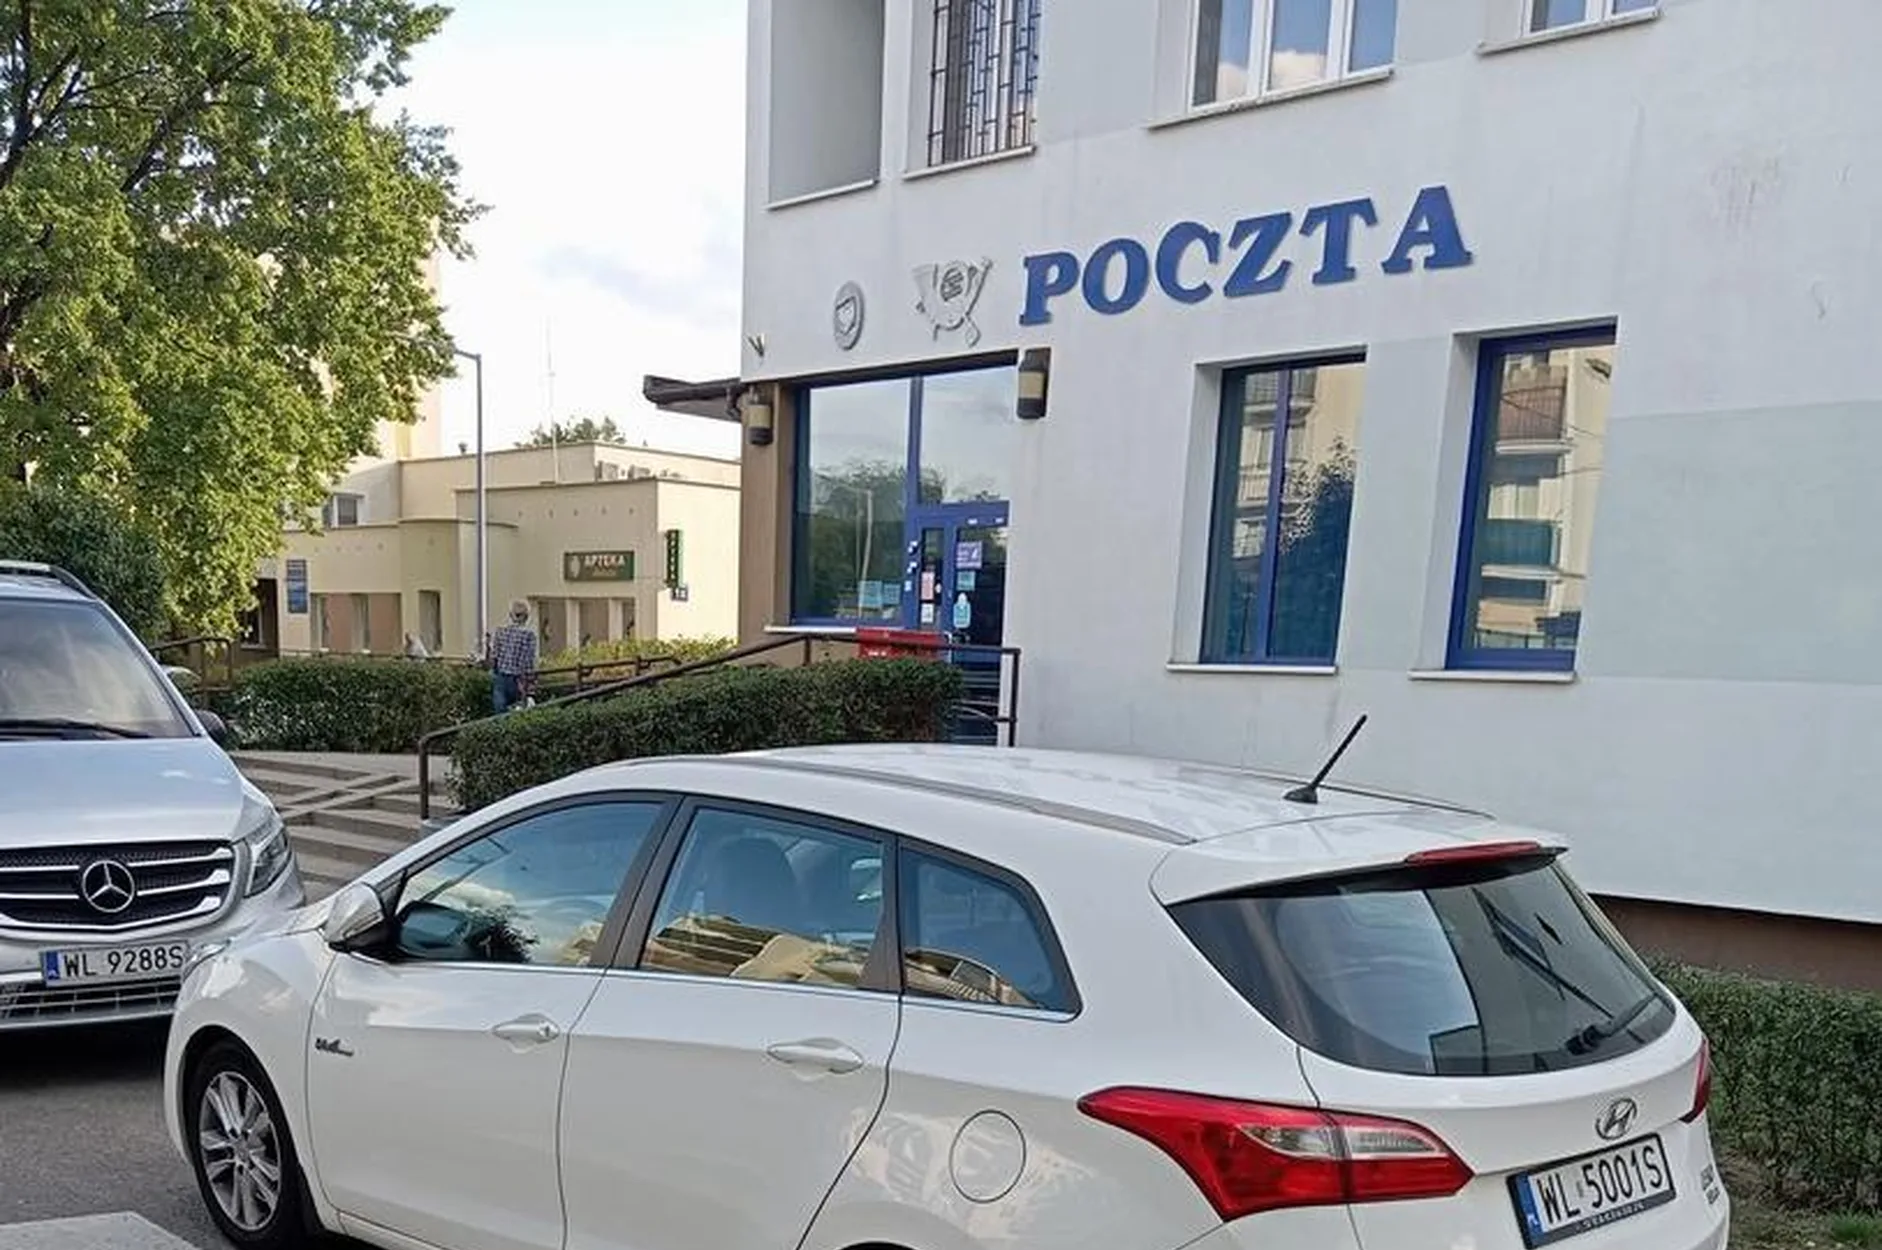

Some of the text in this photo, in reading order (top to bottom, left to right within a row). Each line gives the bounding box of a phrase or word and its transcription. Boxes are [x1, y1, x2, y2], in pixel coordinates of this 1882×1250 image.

[1019, 184, 1474, 326] POCZTA
[584, 554, 626, 567] APTEKA
[63, 945, 184, 978] WL 9288S
[1536, 1172, 1580, 1225] WL
[1581, 1145, 1663, 1210] 5001S
